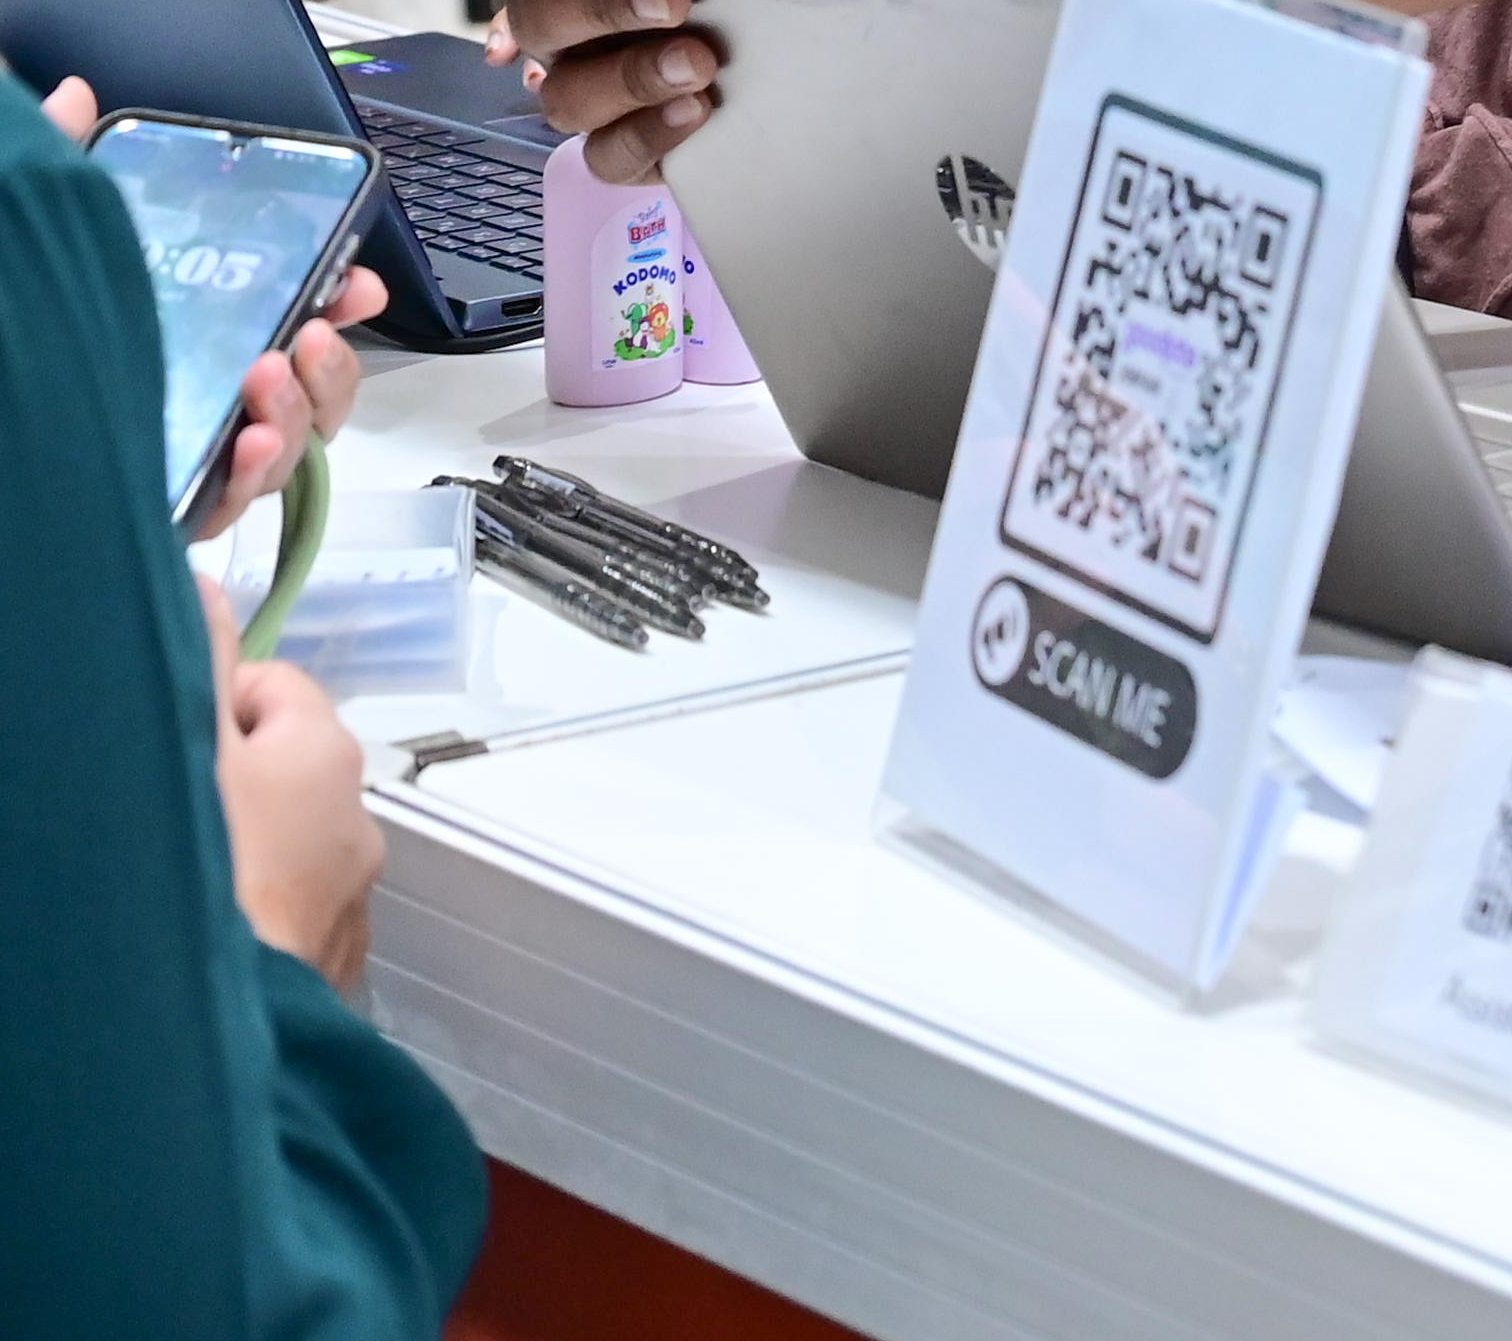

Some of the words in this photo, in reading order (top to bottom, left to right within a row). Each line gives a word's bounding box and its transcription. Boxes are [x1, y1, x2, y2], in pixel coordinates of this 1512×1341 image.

[613, 265, 676, 296] KODOMO
[1027, 629, 1118, 718] SCAN
[1112, 672, 1172, 749] ME
